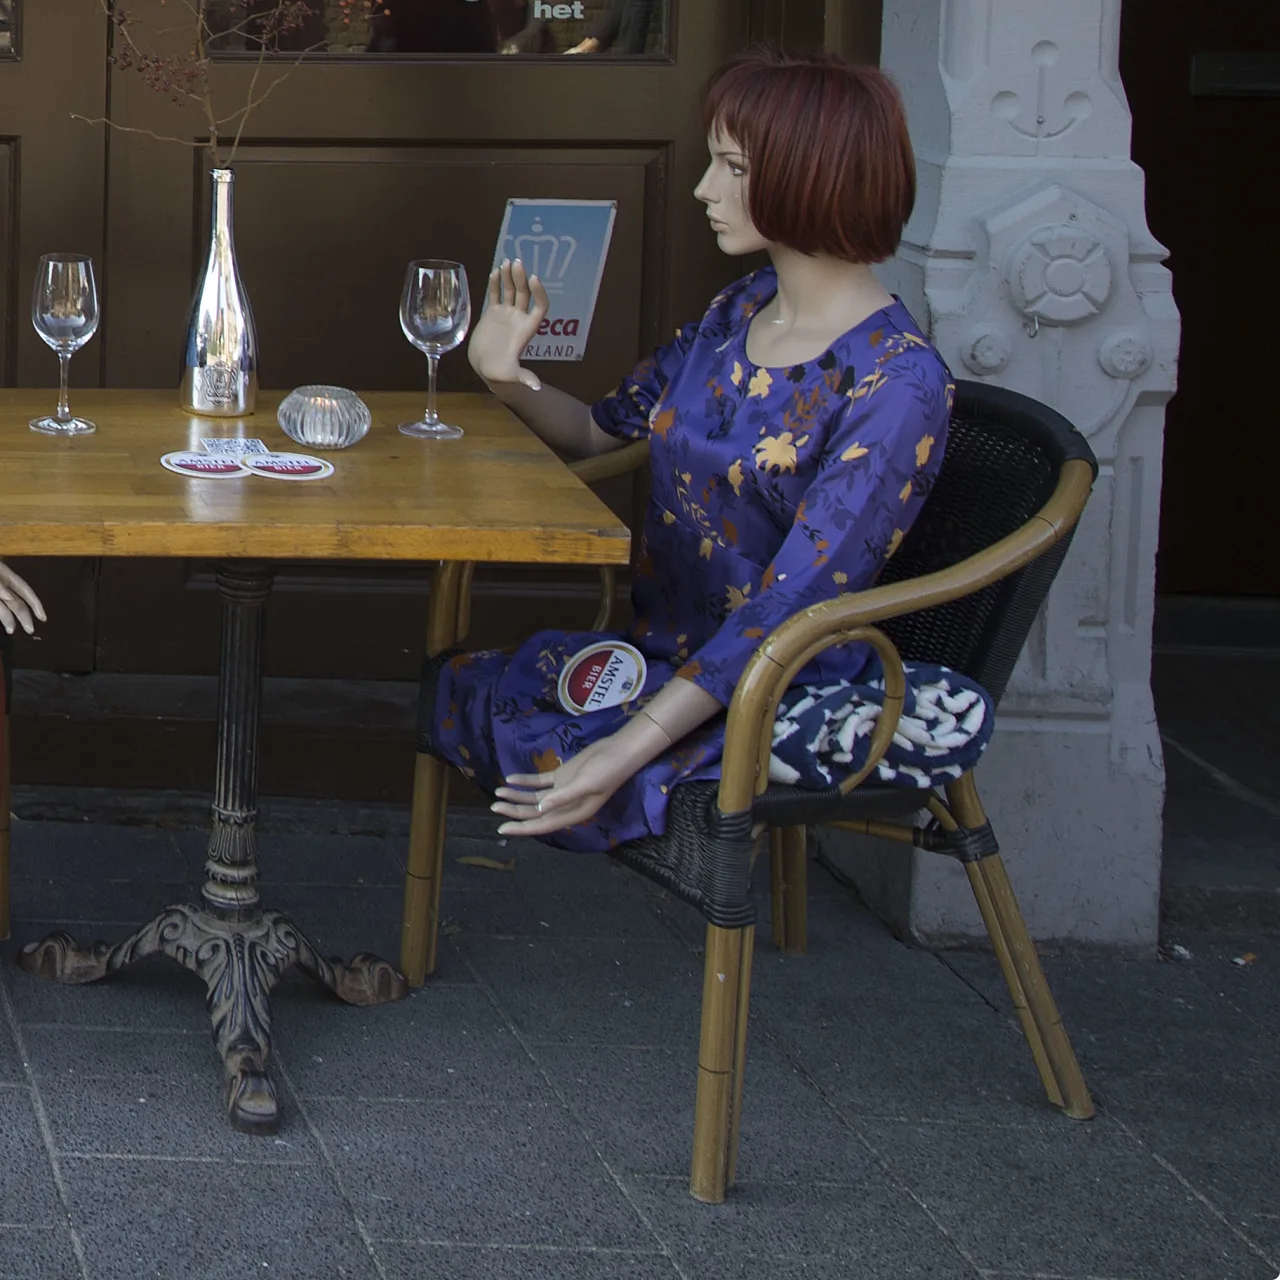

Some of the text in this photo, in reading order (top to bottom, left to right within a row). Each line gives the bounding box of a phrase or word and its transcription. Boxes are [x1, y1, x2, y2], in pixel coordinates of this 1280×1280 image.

[534, 0, 584, 19] het
[536, 318, 580, 337] eca
[525, 344, 575, 358] RLAND
[582, 664, 602, 690] BIER
[588, 654, 624, 705] AMSTEL
